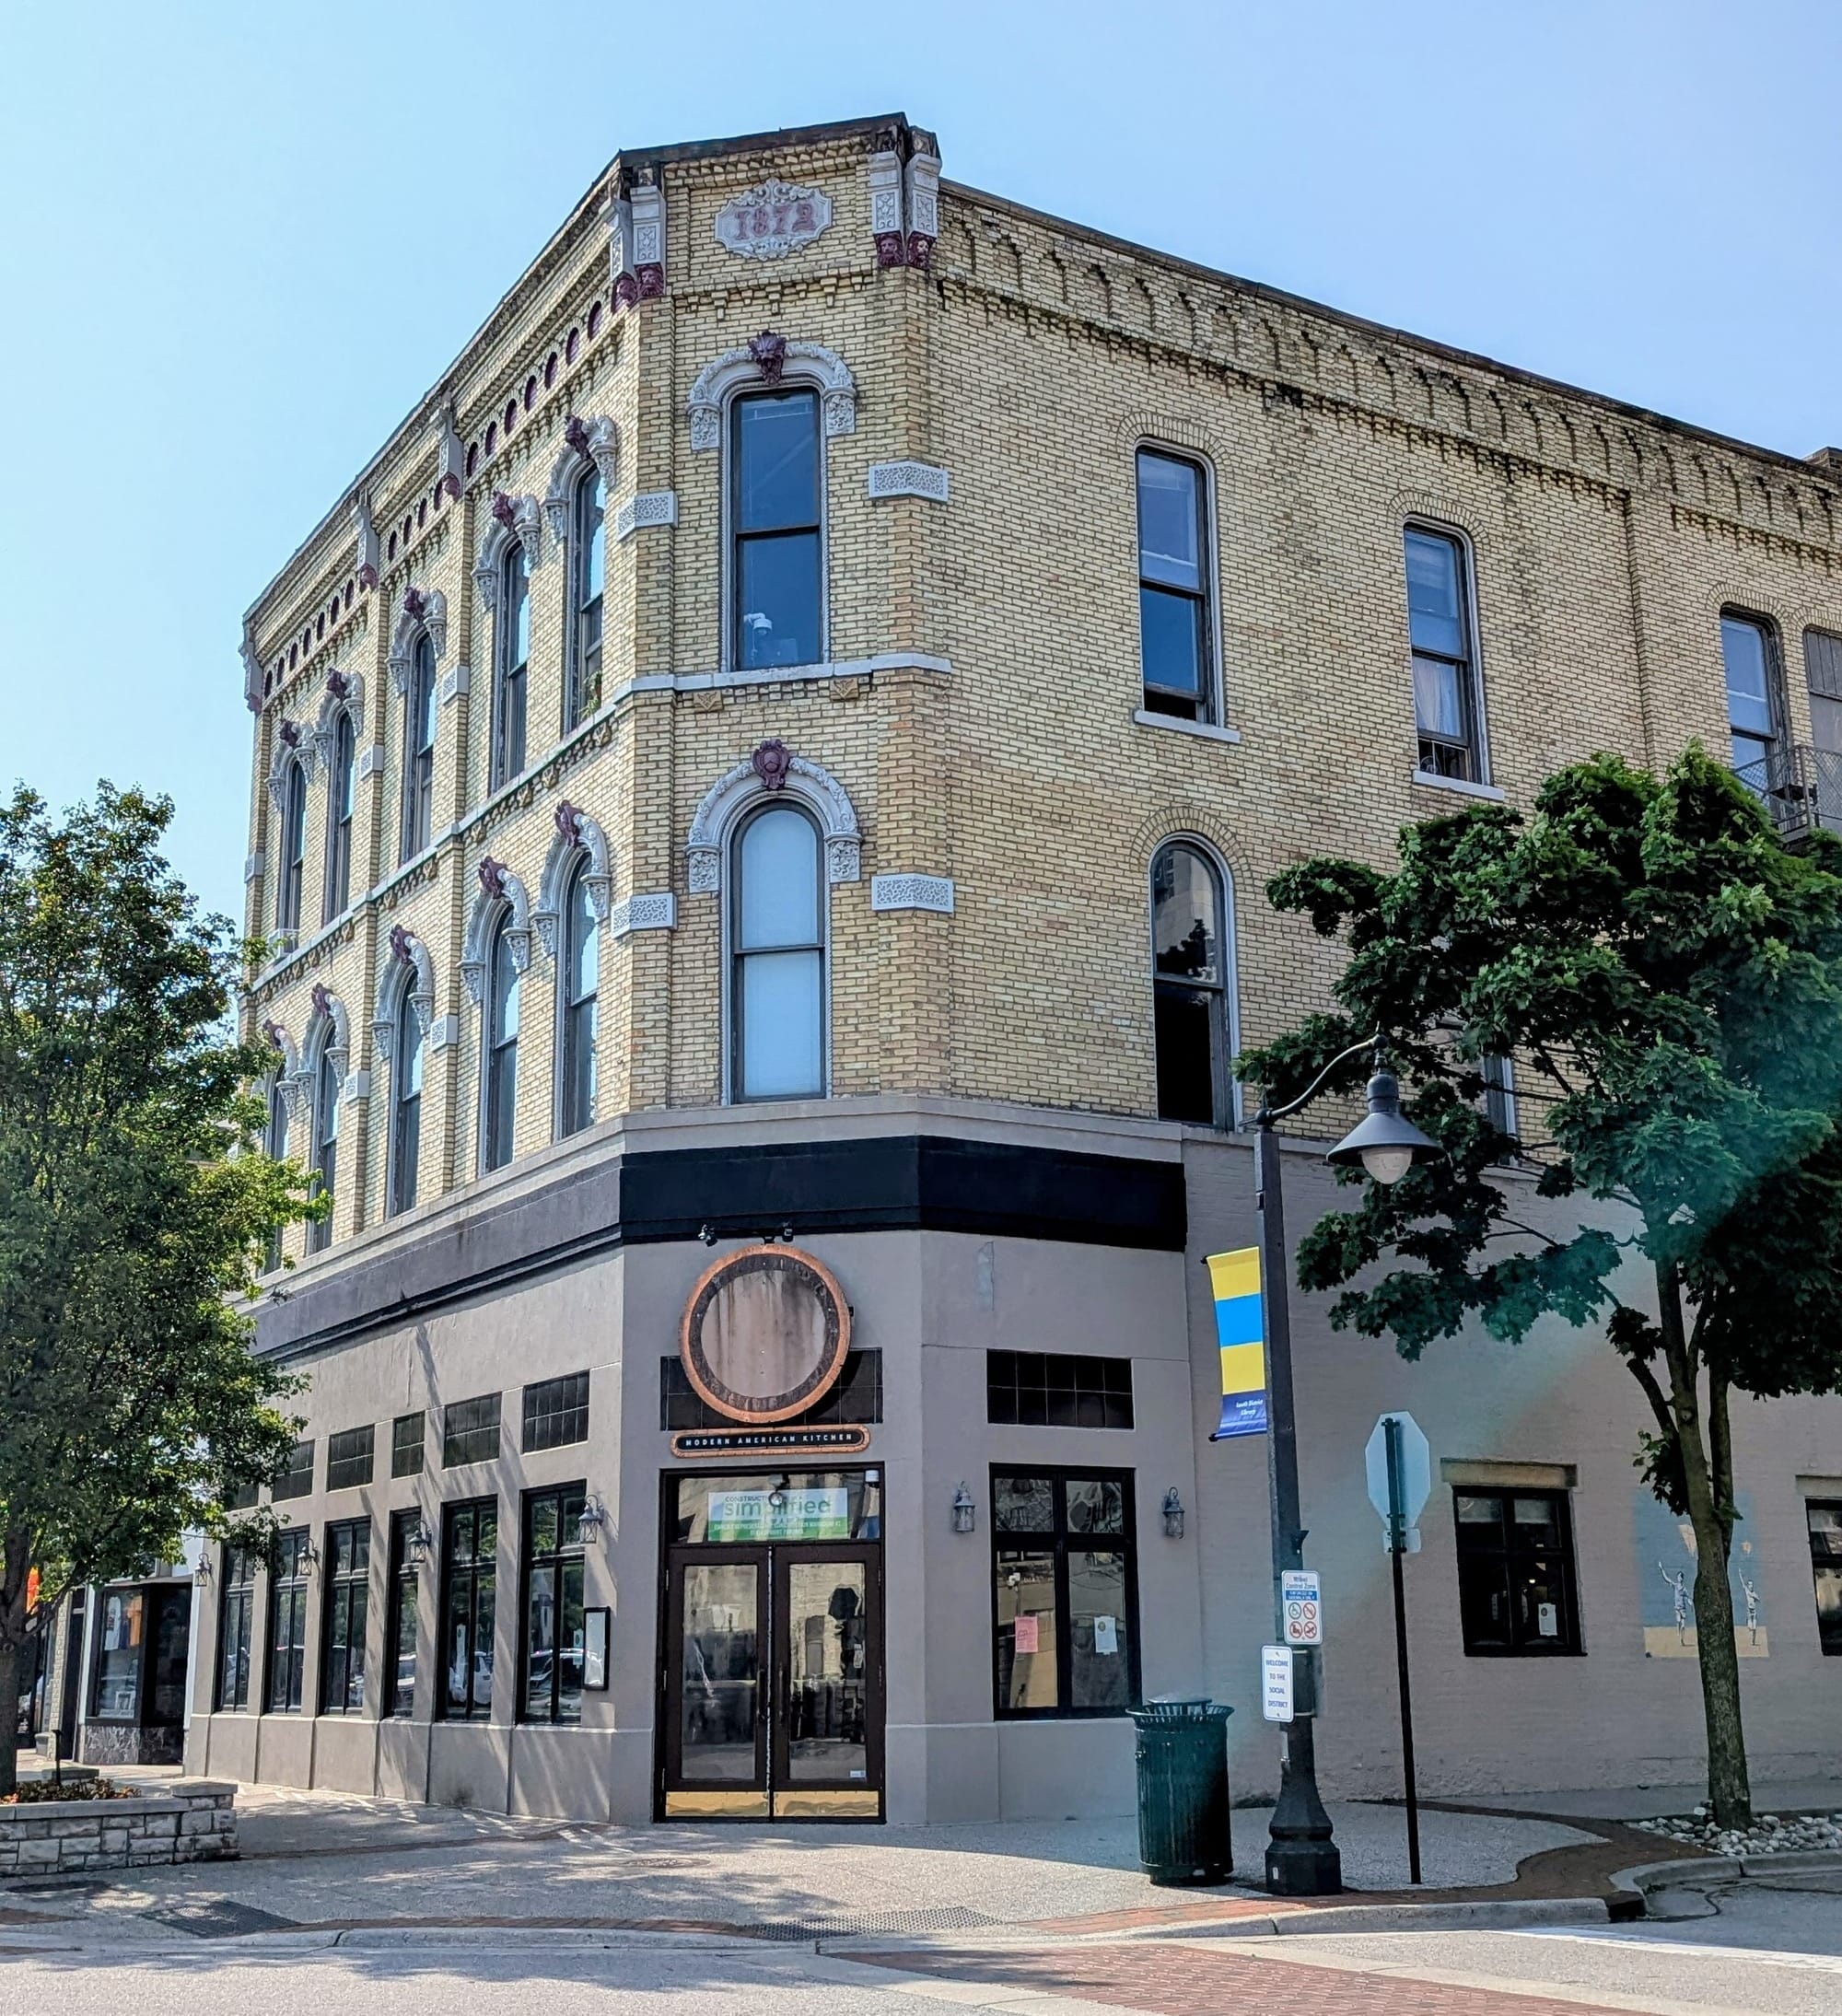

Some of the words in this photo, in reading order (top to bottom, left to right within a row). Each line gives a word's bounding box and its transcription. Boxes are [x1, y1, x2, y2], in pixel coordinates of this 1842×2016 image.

[734, 203, 816, 241] 1872
[685, 1438, 730, 1447] MODERN
[737, 1436, 796, 1445] AMERICAN
[724, 1495, 779, 1503] CONSTRUCTI
[1265, 1659, 1288, 1667] WELCOME
[1269, 1686, 1285, 1695] SOCIAL
[1267, 1700, 1288, 1708] DISTRICT
